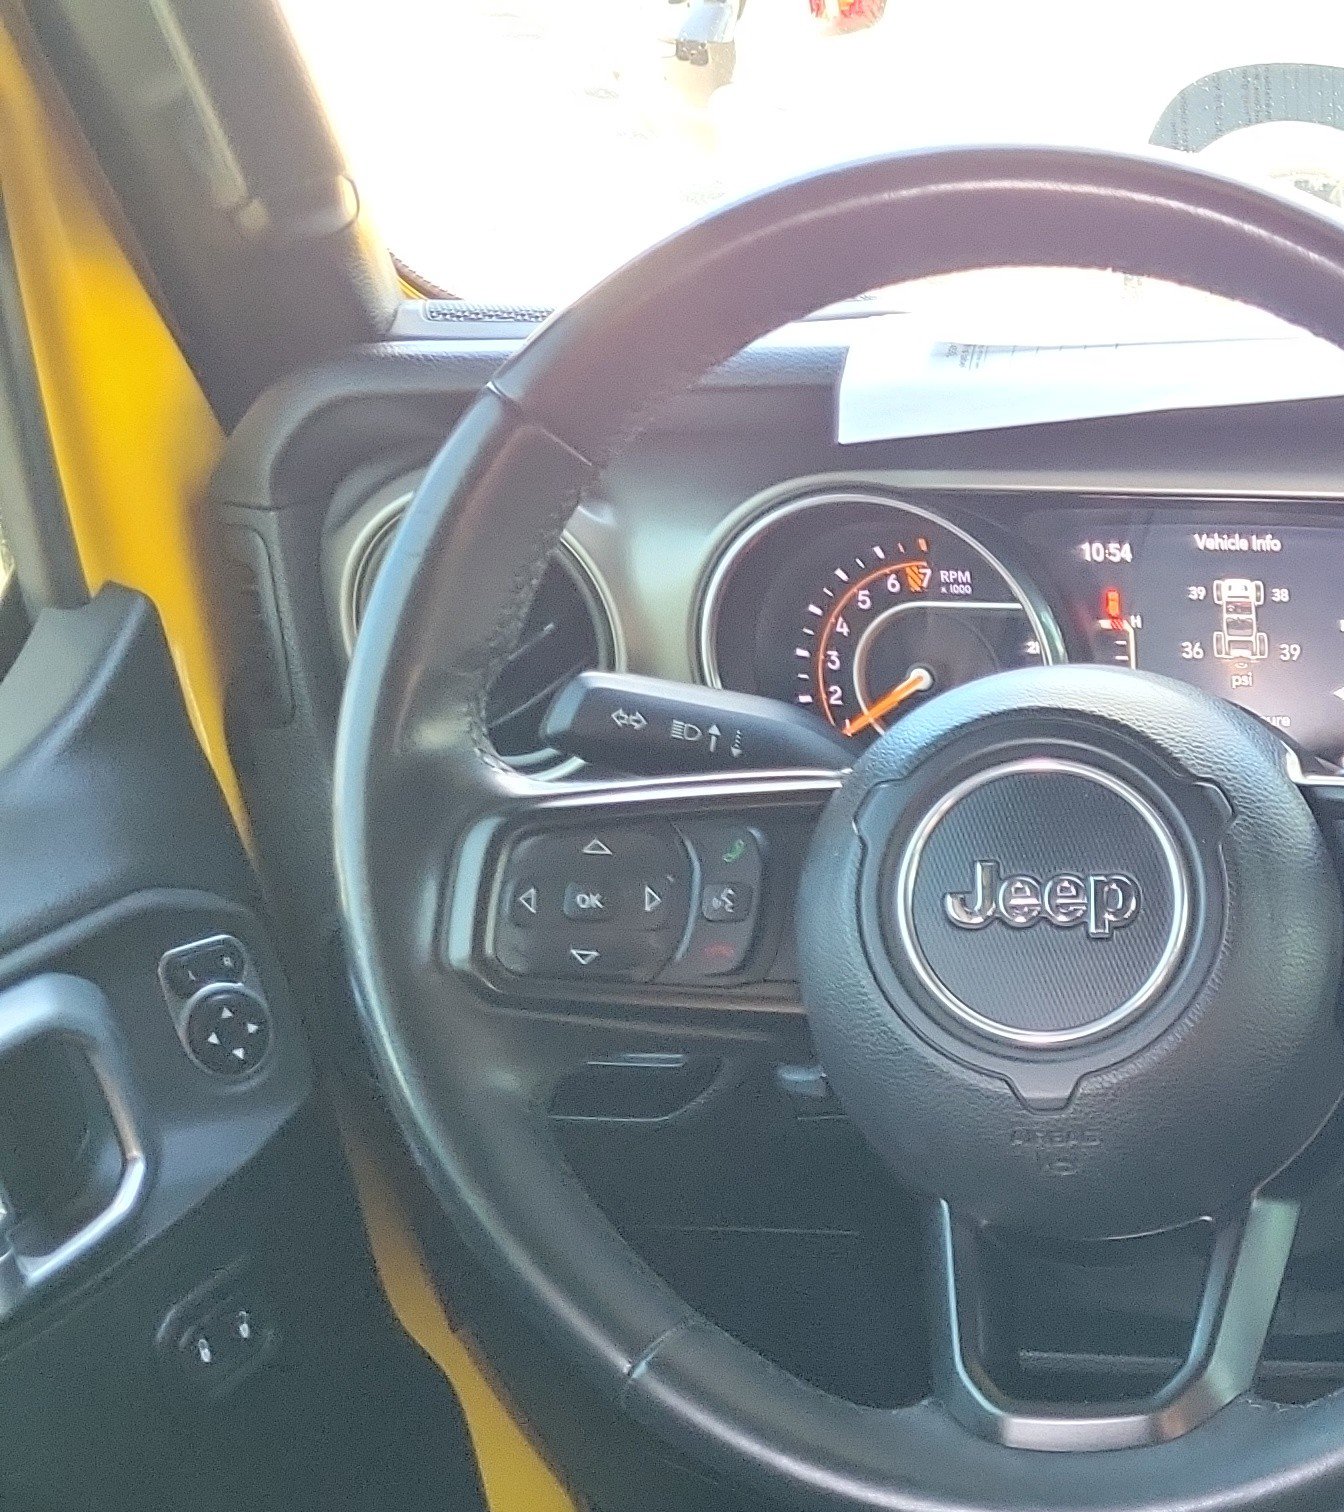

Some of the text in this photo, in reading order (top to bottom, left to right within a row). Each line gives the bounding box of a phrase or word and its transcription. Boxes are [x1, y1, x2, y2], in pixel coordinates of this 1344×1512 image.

[1194, 533, 1282, 552] Vehicle Info
[1081, 542, 1133, 562] 10:54
[886, 577, 900, 593] 6
[920, 568, 932, 588] 7
[939, 570, 972, 584] RPM
[949, 584, 972, 595] 1000
[1188, 586, 1206, 600] 39
[1272, 588, 1289, 602] 38
[857, 590, 872, 610] 5
[836, 617, 850, 637] 4
[1130, 615, 1142, 628] H
[1181, 641, 1204, 659] 36
[1279, 644, 1301, 661] 39
[827, 650, 841, 671] 3
[1231, 671, 1254, 689] psi
[829, 686, 844, 705] 2
[576, 892, 604, 909] OK
[942, 859, 1143, 939] Jeep
